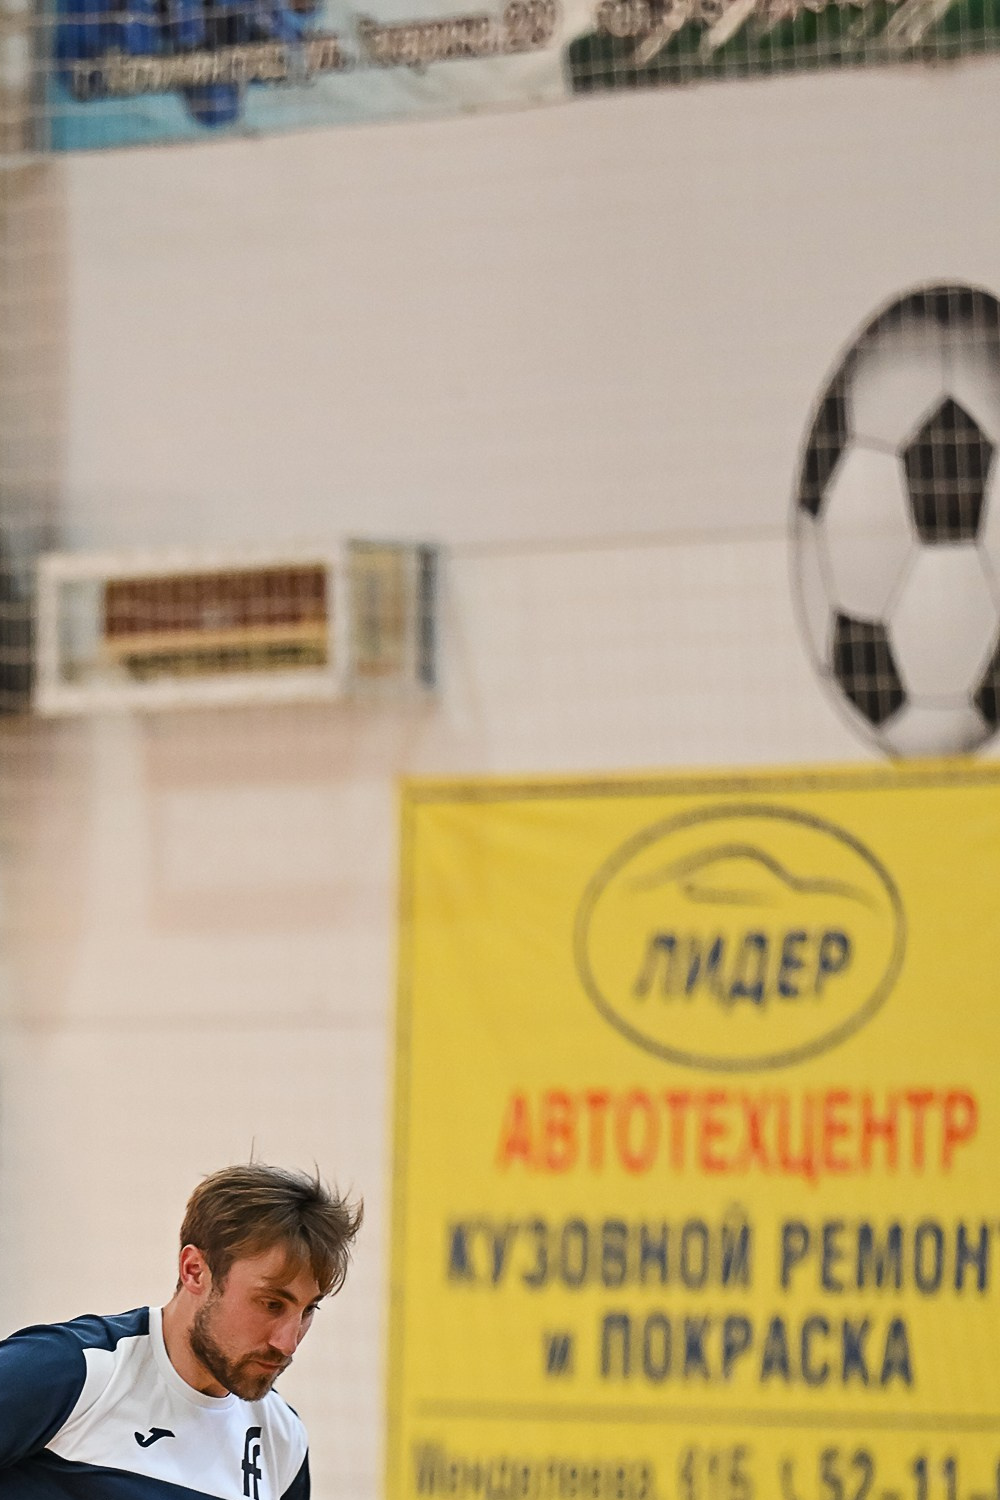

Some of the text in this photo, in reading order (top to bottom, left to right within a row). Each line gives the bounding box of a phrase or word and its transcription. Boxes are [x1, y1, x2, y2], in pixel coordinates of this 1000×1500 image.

[633, 928, 853, 1008] ЛИДЕР
[499, 1088, 979, 1186] АВТОТЕХЦЕНТР
[446, 1204, 751, 1291] КУЗОВНОЙ
[544, 1312, 914, 1387] и ПОКРАСКА
